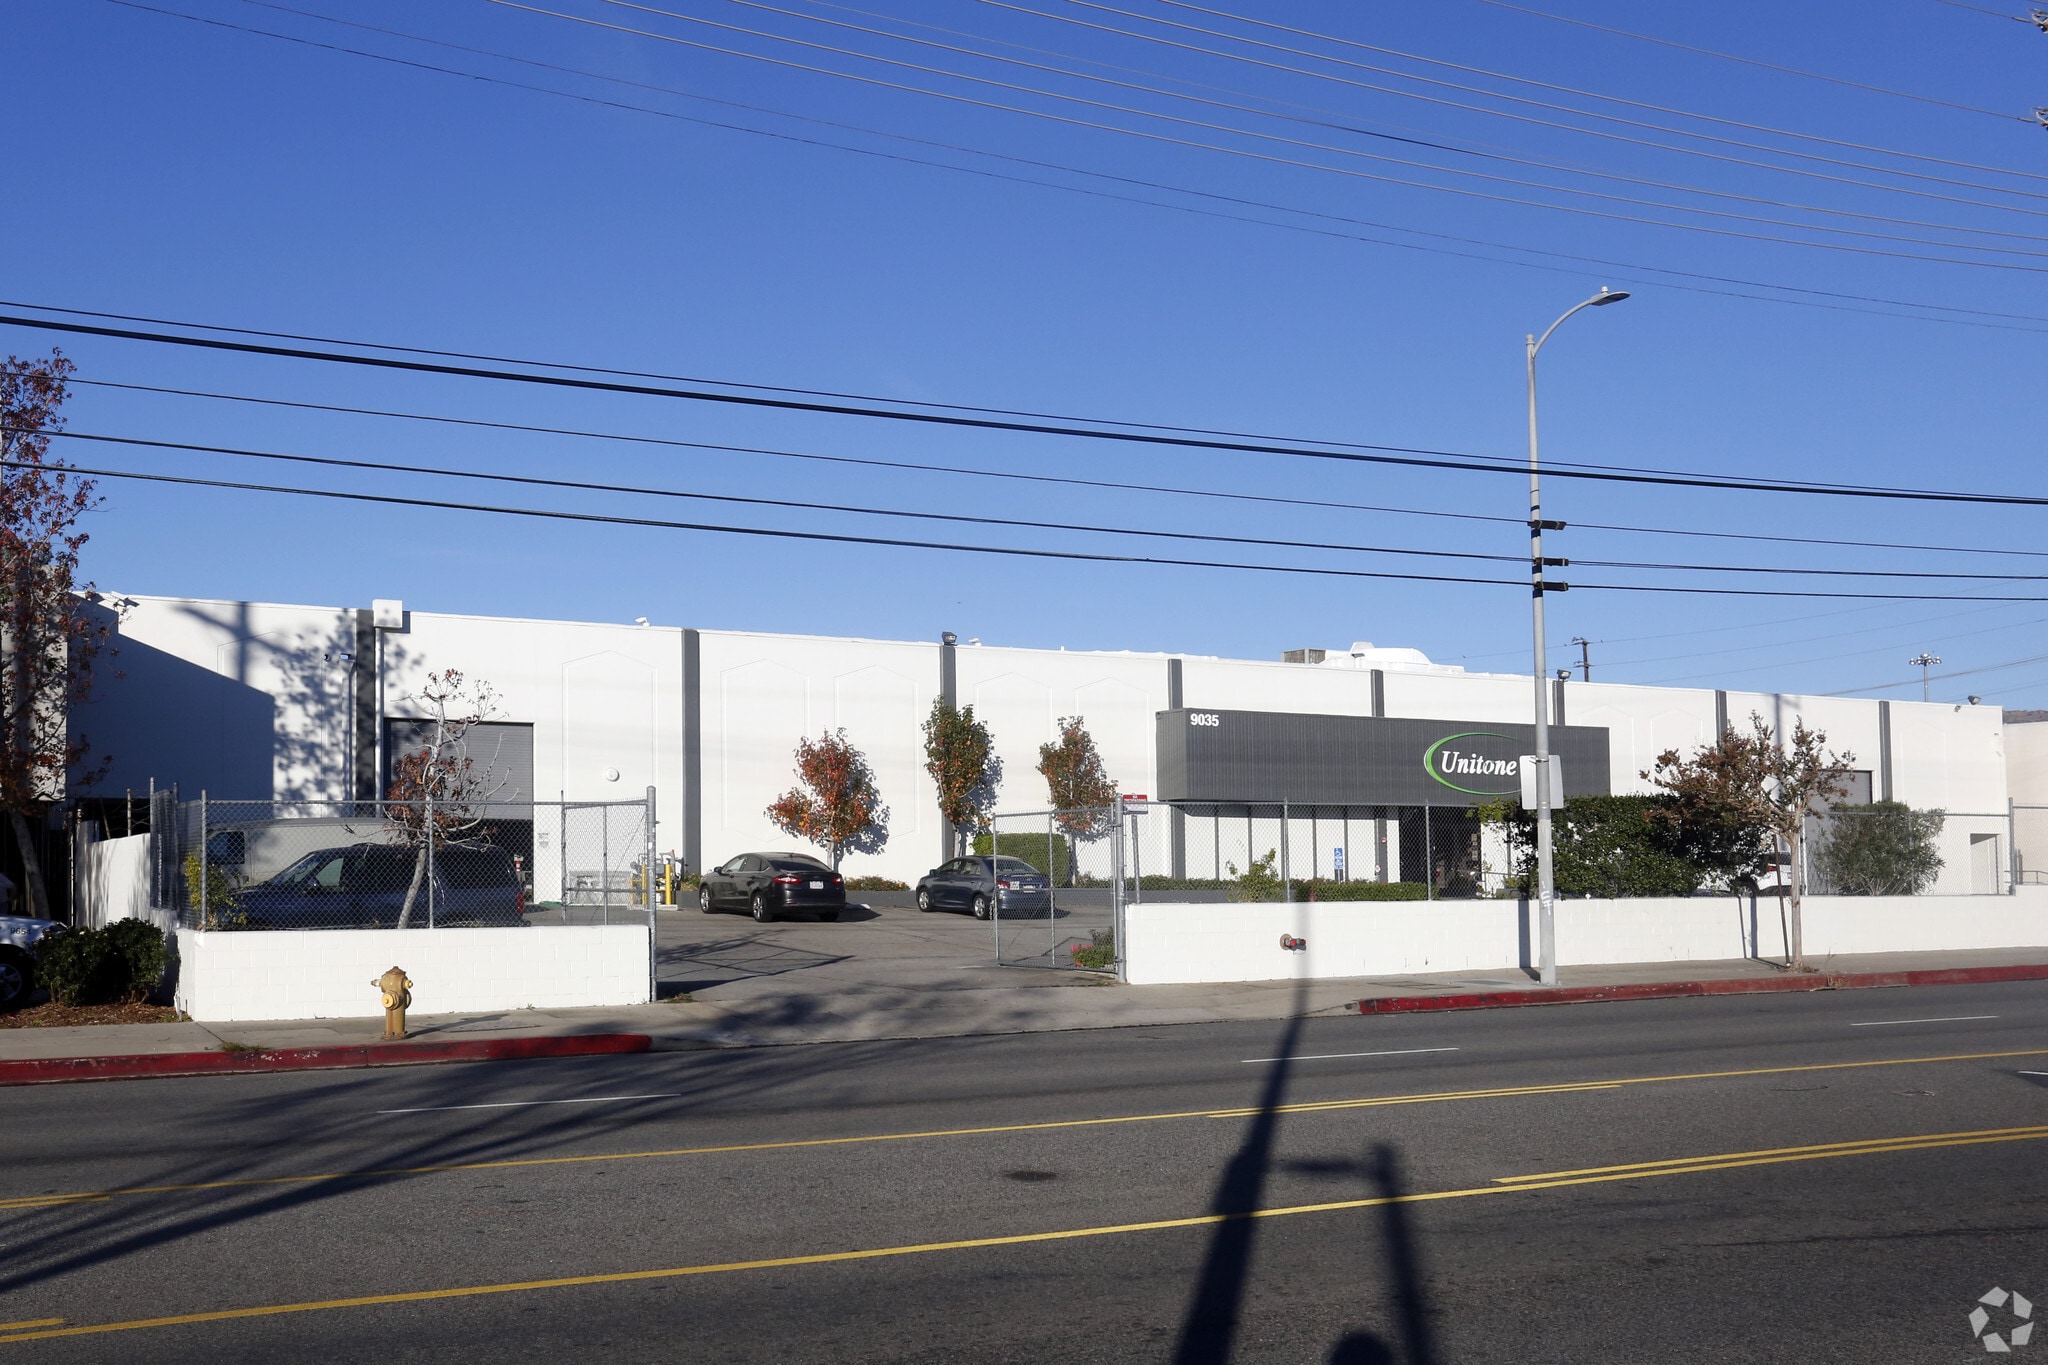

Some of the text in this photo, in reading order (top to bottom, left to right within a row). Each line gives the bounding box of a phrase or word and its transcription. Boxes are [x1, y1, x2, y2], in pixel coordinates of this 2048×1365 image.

[1190, 713, 1219, 727] 9035
[1441, 750, 1517, 776] Unitone
[10, 927, 31, 935] 9654
